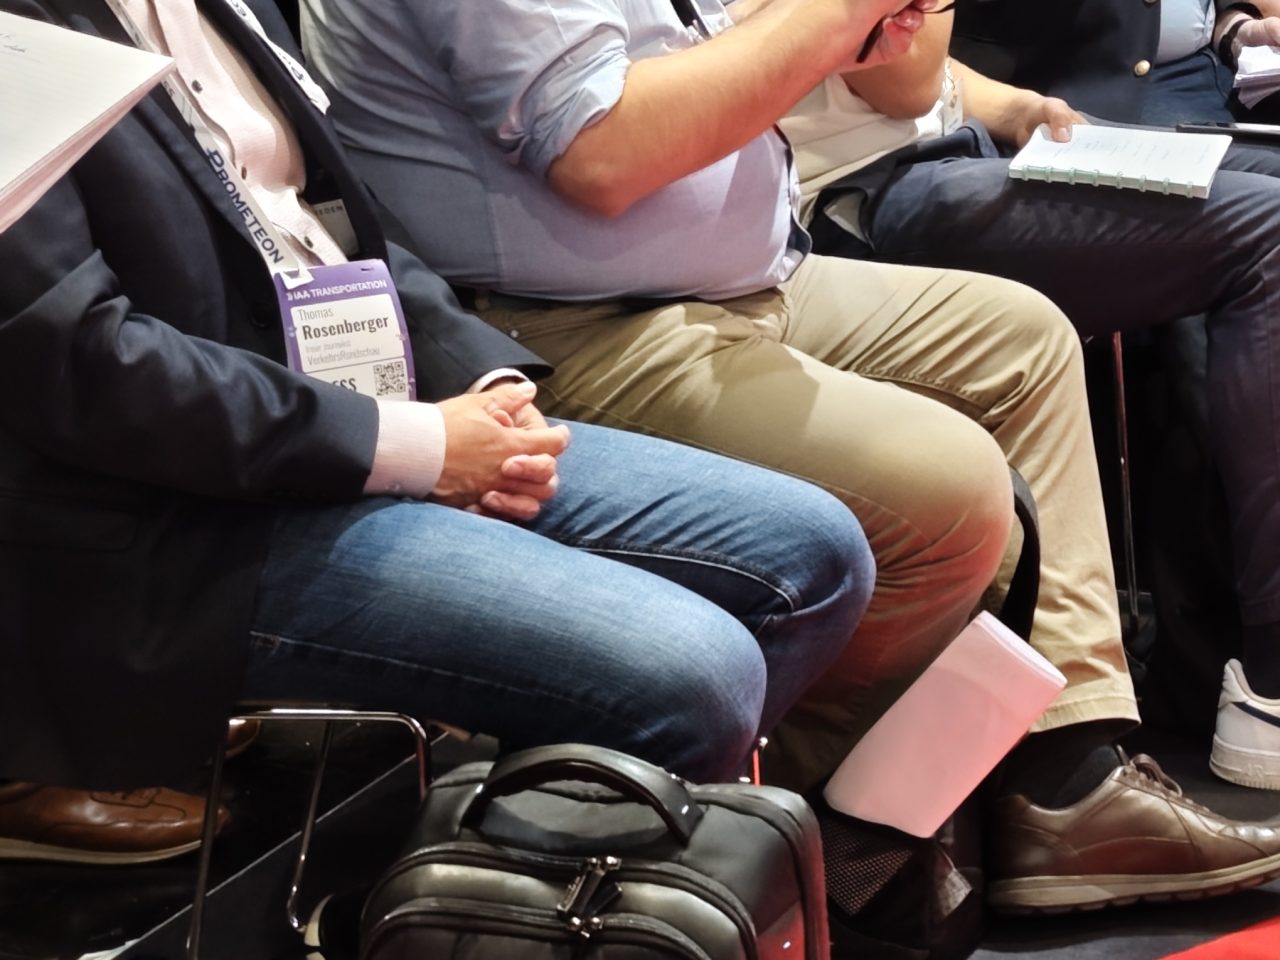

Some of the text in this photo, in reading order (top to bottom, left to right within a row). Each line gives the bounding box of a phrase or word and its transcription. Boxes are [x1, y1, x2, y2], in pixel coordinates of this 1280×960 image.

[206, 148, 285, 264] PROMETEON
[293, 279, 388, 300] IAA TRANSPORTATION
[297, 308, 334, 321] Thomas
[302, 317, 389, 340] Rosenberger
